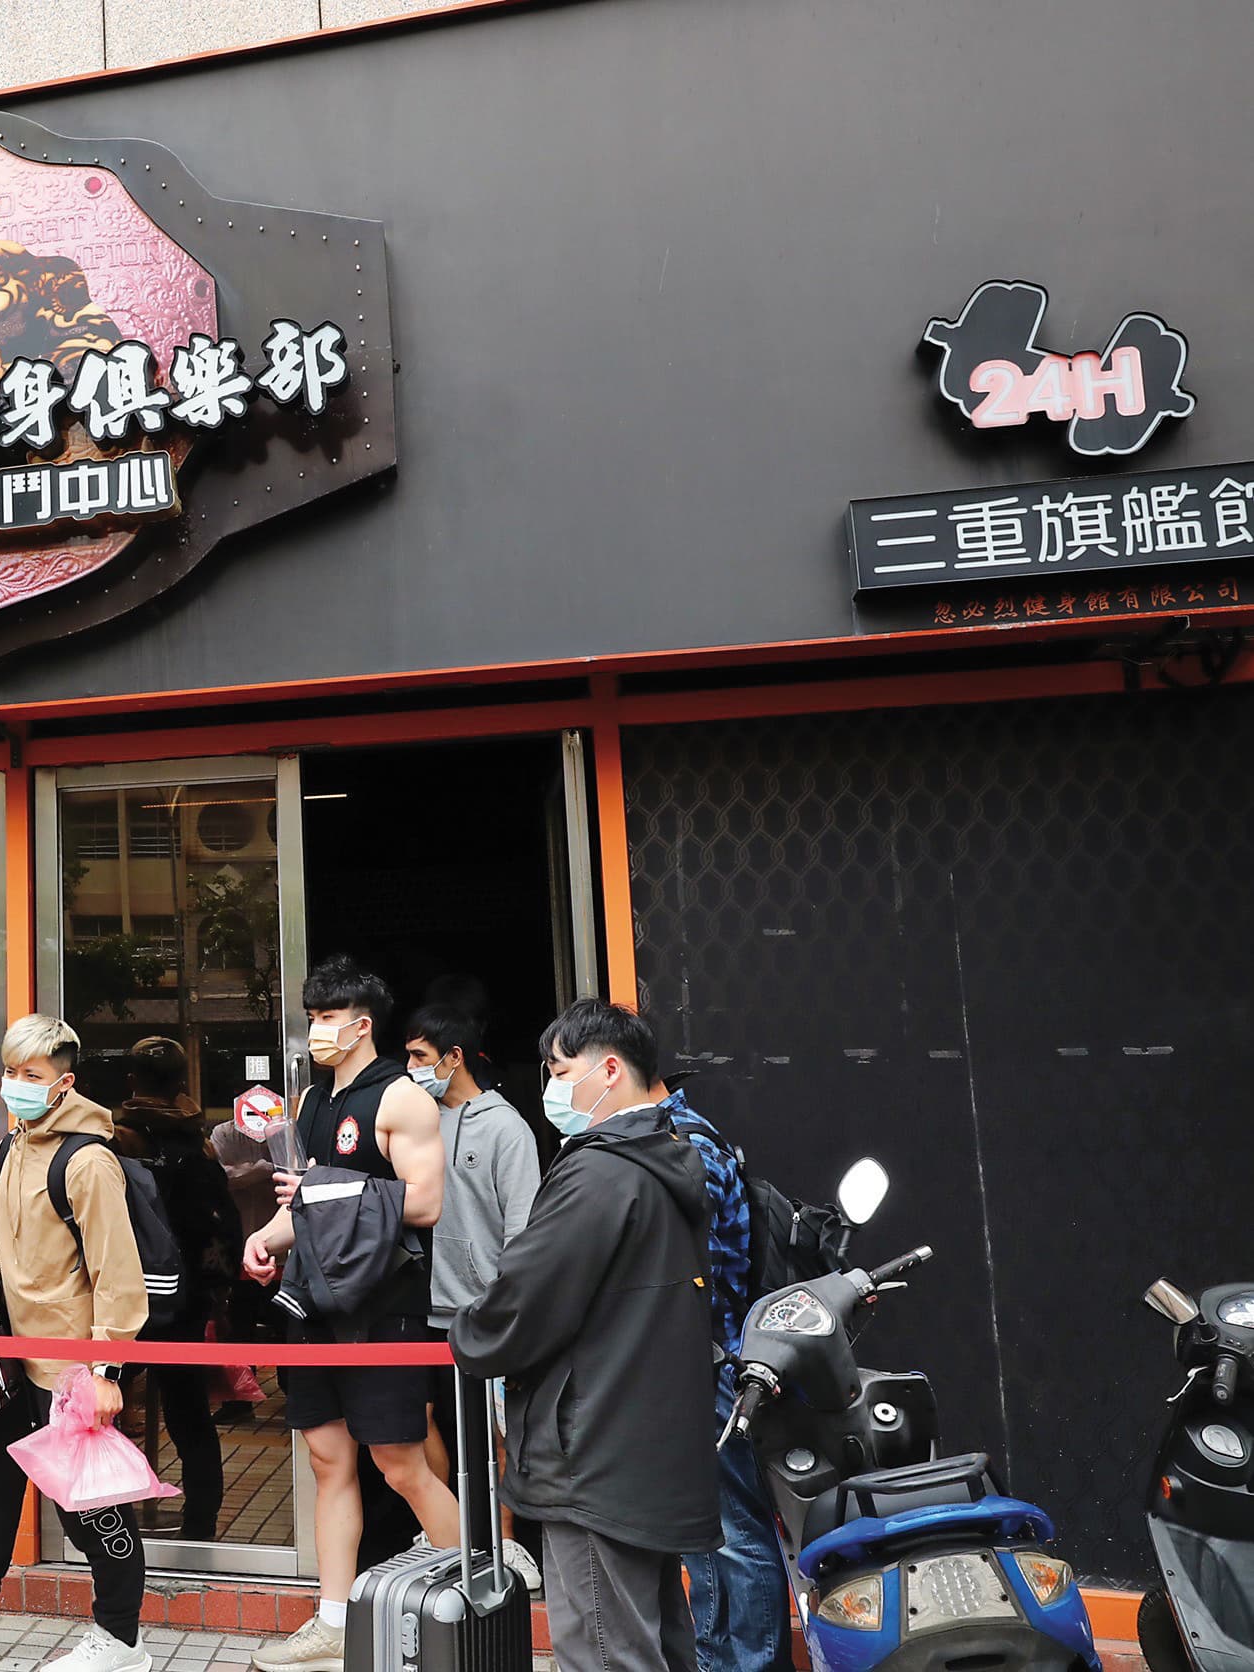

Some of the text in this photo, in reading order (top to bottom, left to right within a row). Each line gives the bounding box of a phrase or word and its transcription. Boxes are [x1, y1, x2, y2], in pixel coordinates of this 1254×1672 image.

[971, 348, 1144, 427] 24H
[934, 580, 1240, 624] 忽必烈健身館有限公司
